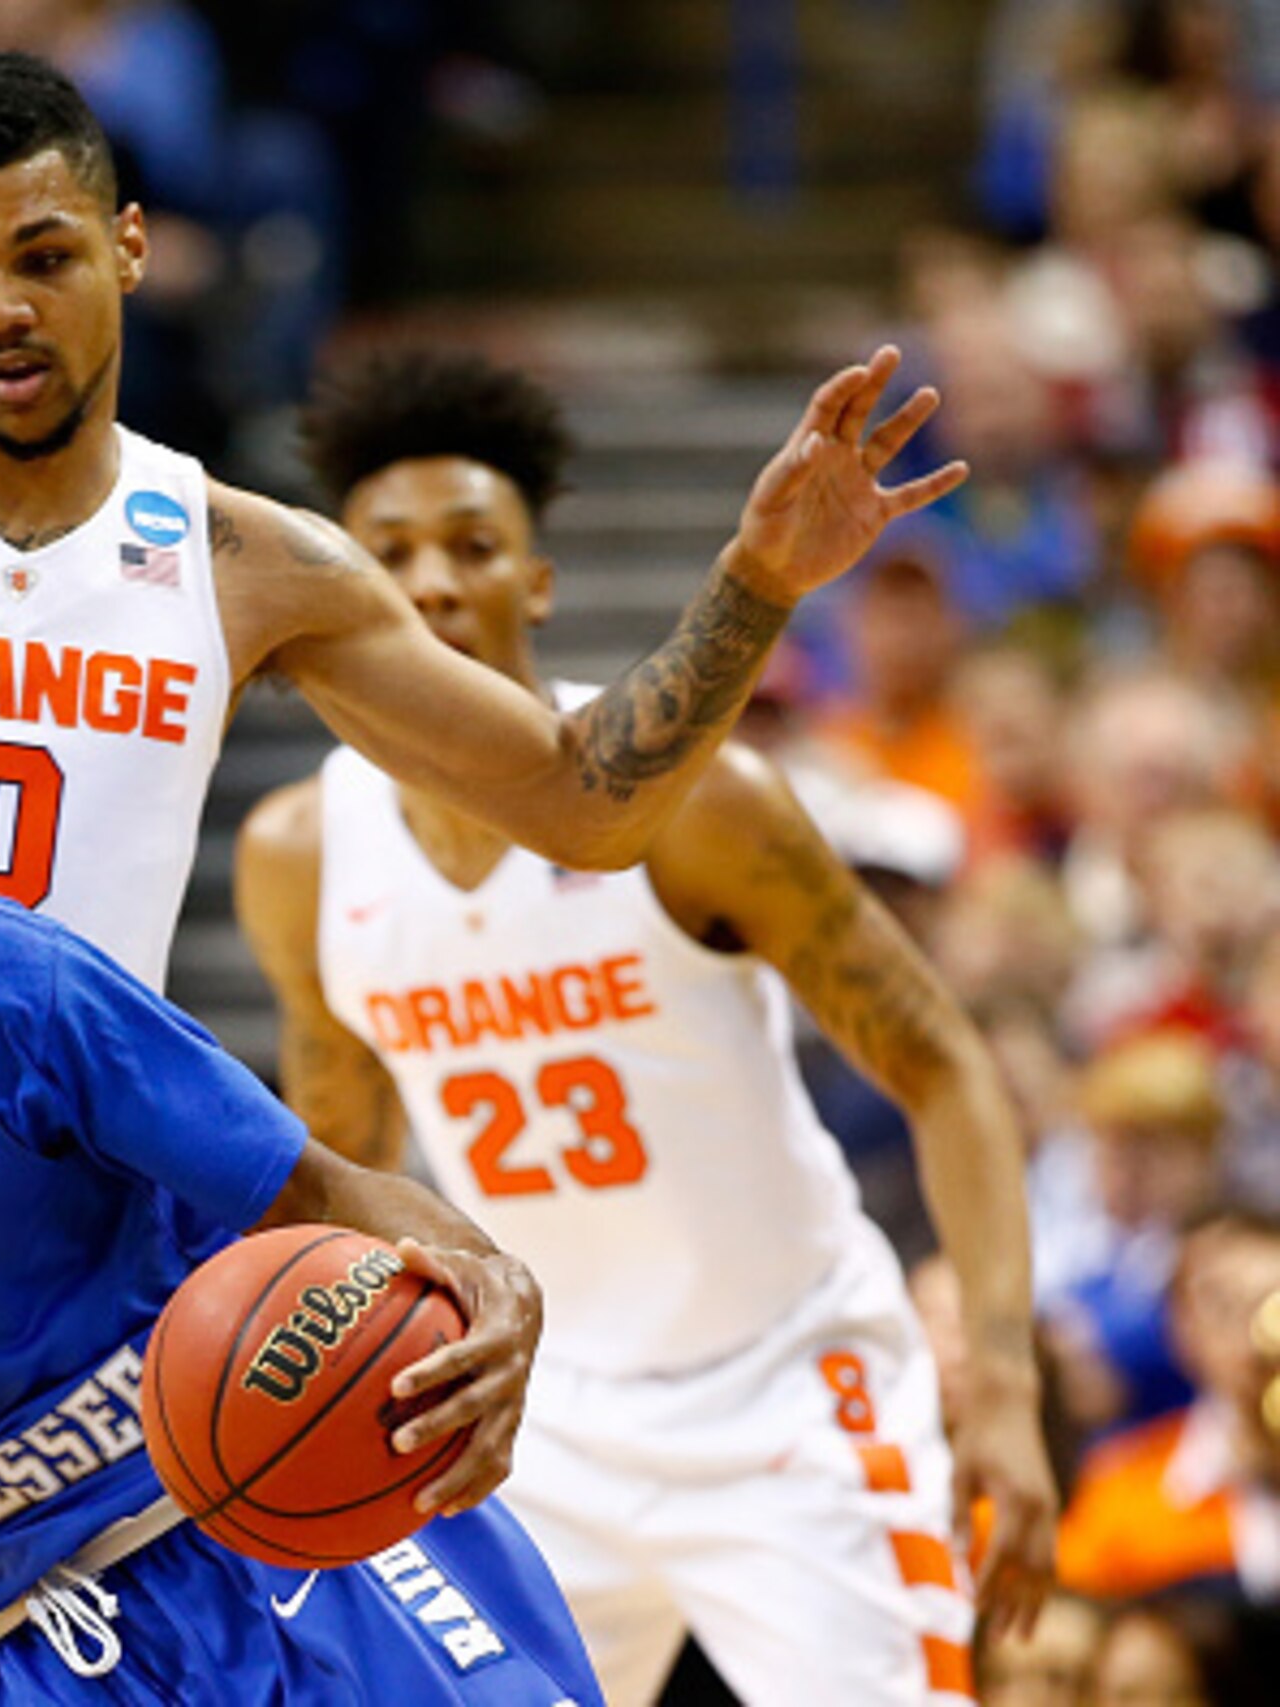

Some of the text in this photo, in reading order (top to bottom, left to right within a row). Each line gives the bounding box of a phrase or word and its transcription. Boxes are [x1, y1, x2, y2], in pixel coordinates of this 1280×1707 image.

[364, 951, 658, 1055] ORANGE
[439, 1055, 650, 1199] 23
[241, 1248, 407, 1404] Wilson
